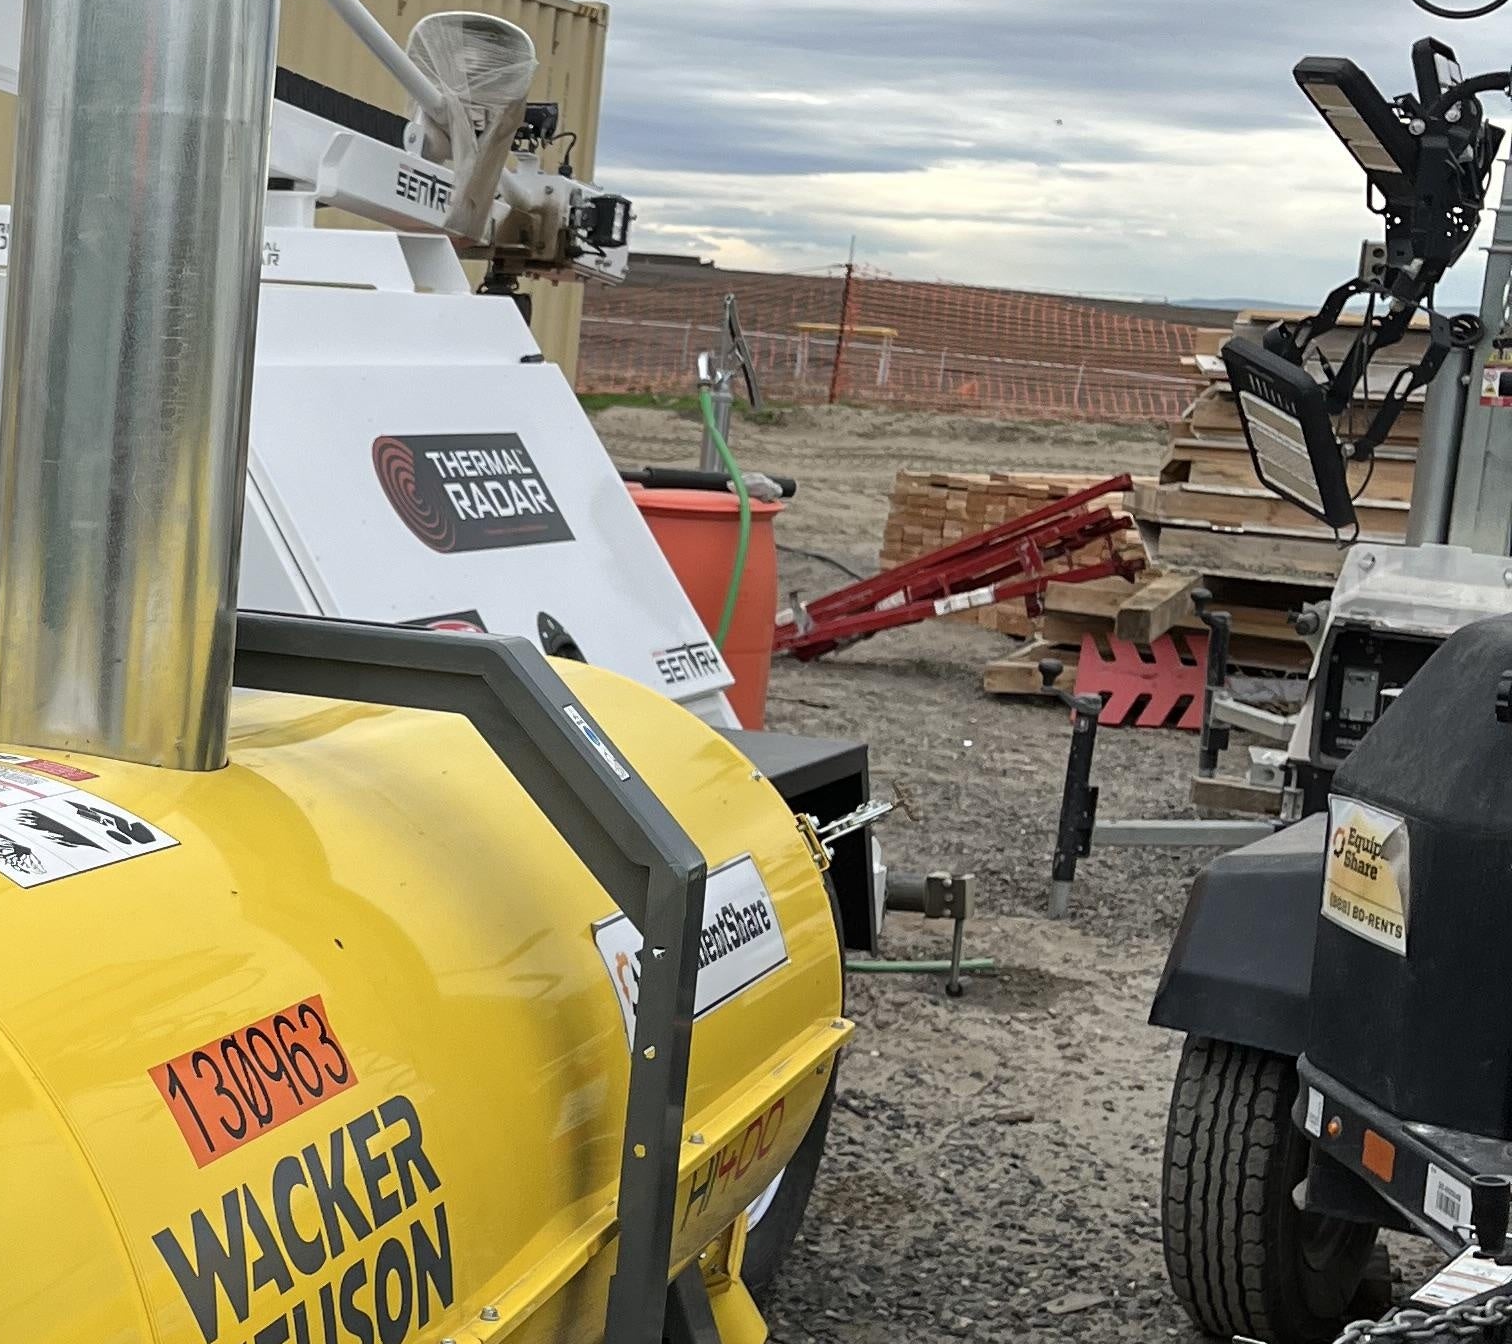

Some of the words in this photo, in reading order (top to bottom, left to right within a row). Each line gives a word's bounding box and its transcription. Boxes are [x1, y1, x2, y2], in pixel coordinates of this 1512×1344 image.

[396, 168, 453, 214] SENTR
[424, 447, 534, 479] THERMAL
[443, 478, 555, 521] RADAR
[655, 642, 722, 685] SENTRY
[1343, 850, 1379, 881] Share
[697, 899, 771, 968] mentShare
[167, 1001, 349, 1154] 130963
